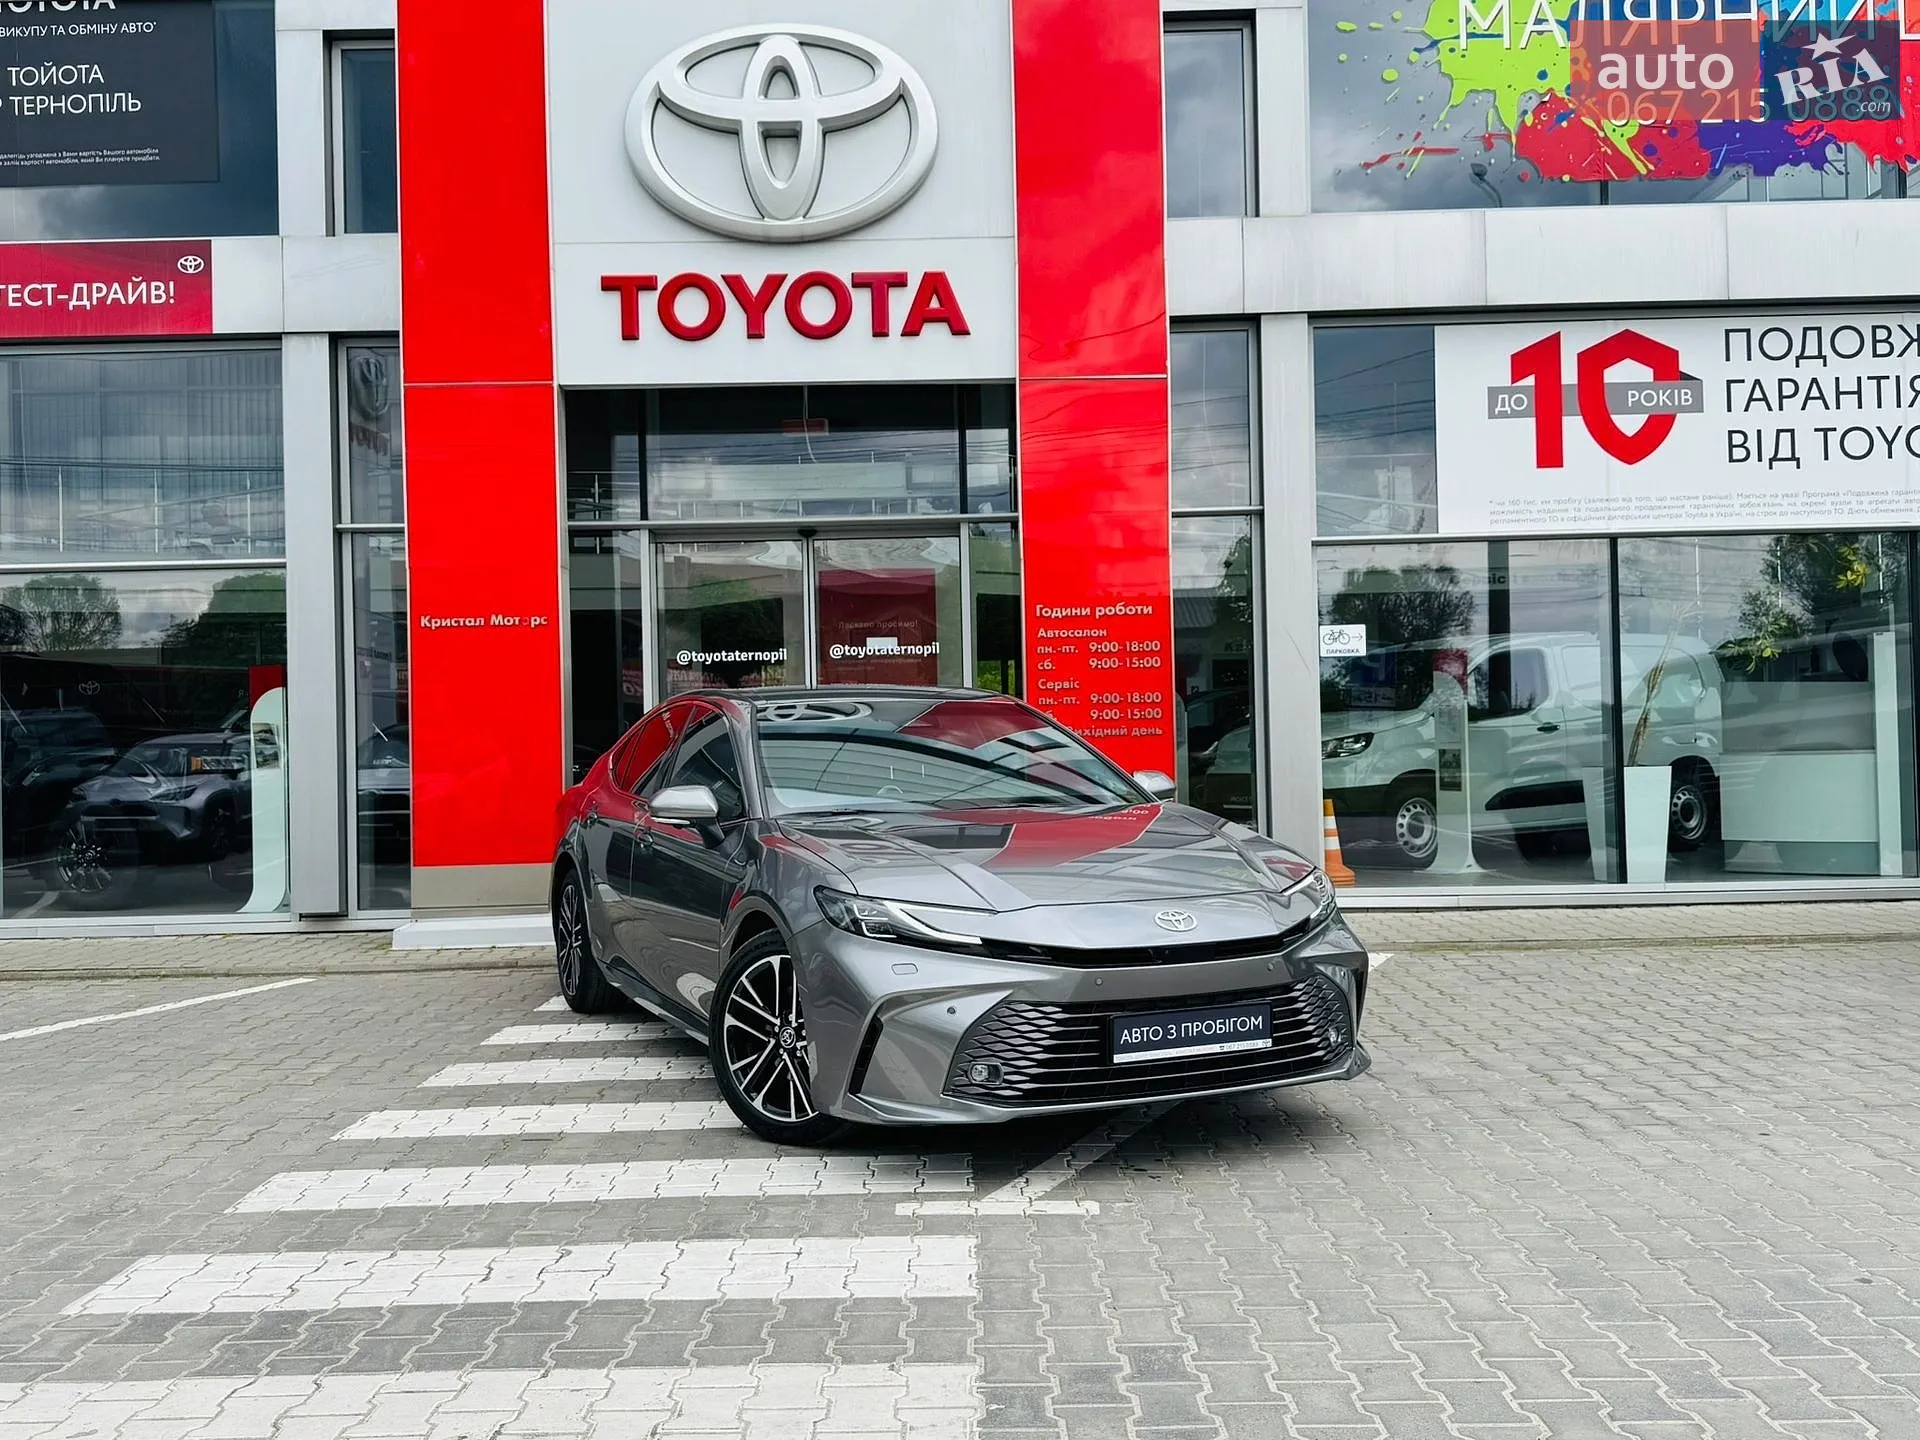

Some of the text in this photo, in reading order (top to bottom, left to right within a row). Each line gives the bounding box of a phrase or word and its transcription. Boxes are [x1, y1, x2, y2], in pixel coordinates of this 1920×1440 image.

[50, 25, 66, 36] ТА
[68, 23, 118, 35] ОБМІНУ
[7, 62, 105, 87] ТОЙОТА
[9, 93, 142, 116] ТЕРНОПІЛЬ
[1606, 91, 1684, 126] 067
[1700, 88, 1772, 124] 215
[600, 270, 972, 342] TOYOTA
[1495, 330, 1693, 469] ДО 10 РОКІВ
[1727, 428, 1801, 471] ВІД
[1036, 602, 1153, 620] Години роботи
[420, 615, 485, 630] Кристал
[1037, 627, 1107, 639] Автосалон
[829, 641, 940, 659] @toyotaternopil
[1037, 641, 1161, 654] пн.-пт. 9:00-18:00
[676, 648, 787, 665] @toyotaternopil
[1037, 657, 1161, 670] сб. 9:00-15:00
[1038, 678, 1080, 692] Сервіс
[1090, 692, 1162, 704] 9:00-18:00
[1090, 708, 1162, 720] 9:00-15:00
[1131, 727, 1163, 737] день
[1120, 1015, 1263, 1045] АВТО З ПРОБІГОМ
